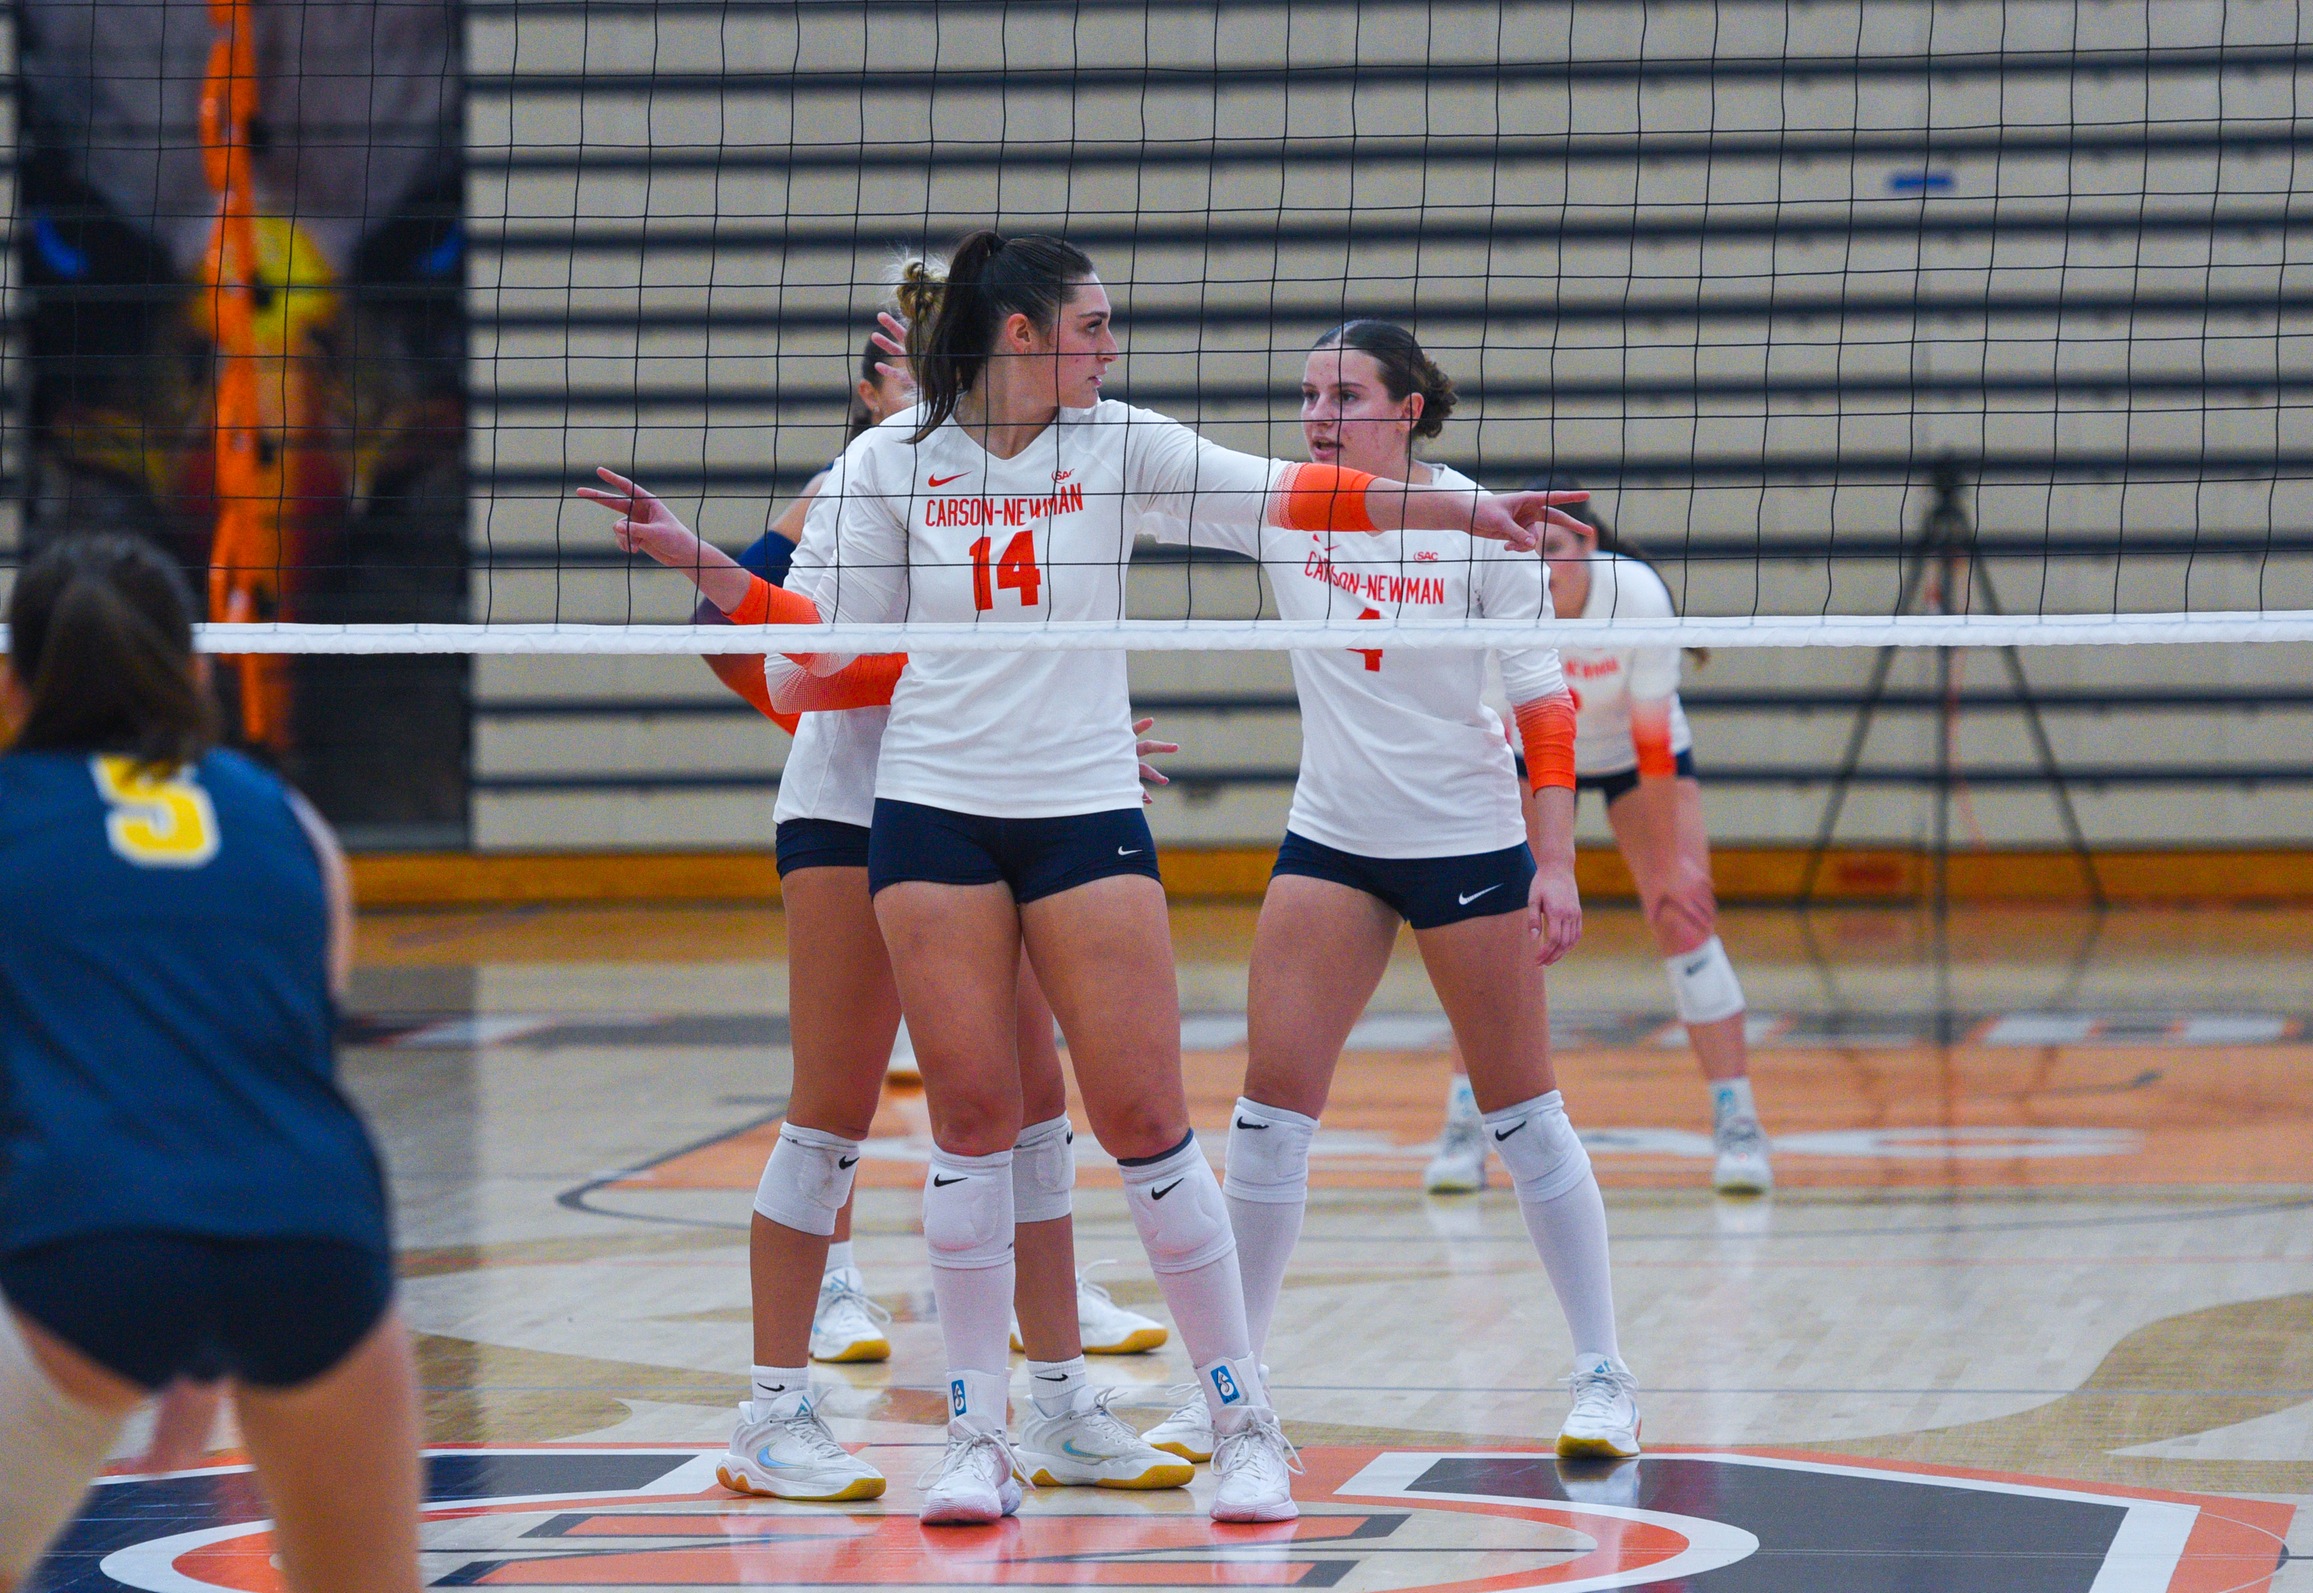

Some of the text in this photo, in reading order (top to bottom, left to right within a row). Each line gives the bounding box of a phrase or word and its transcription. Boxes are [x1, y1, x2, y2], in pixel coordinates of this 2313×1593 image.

[925, 482, 1084, 527] CARSON-NEWMAN
[968, 529, 1041, 611] 14
[1304, 550, 1445, 605] CARSON-NEWMAN
